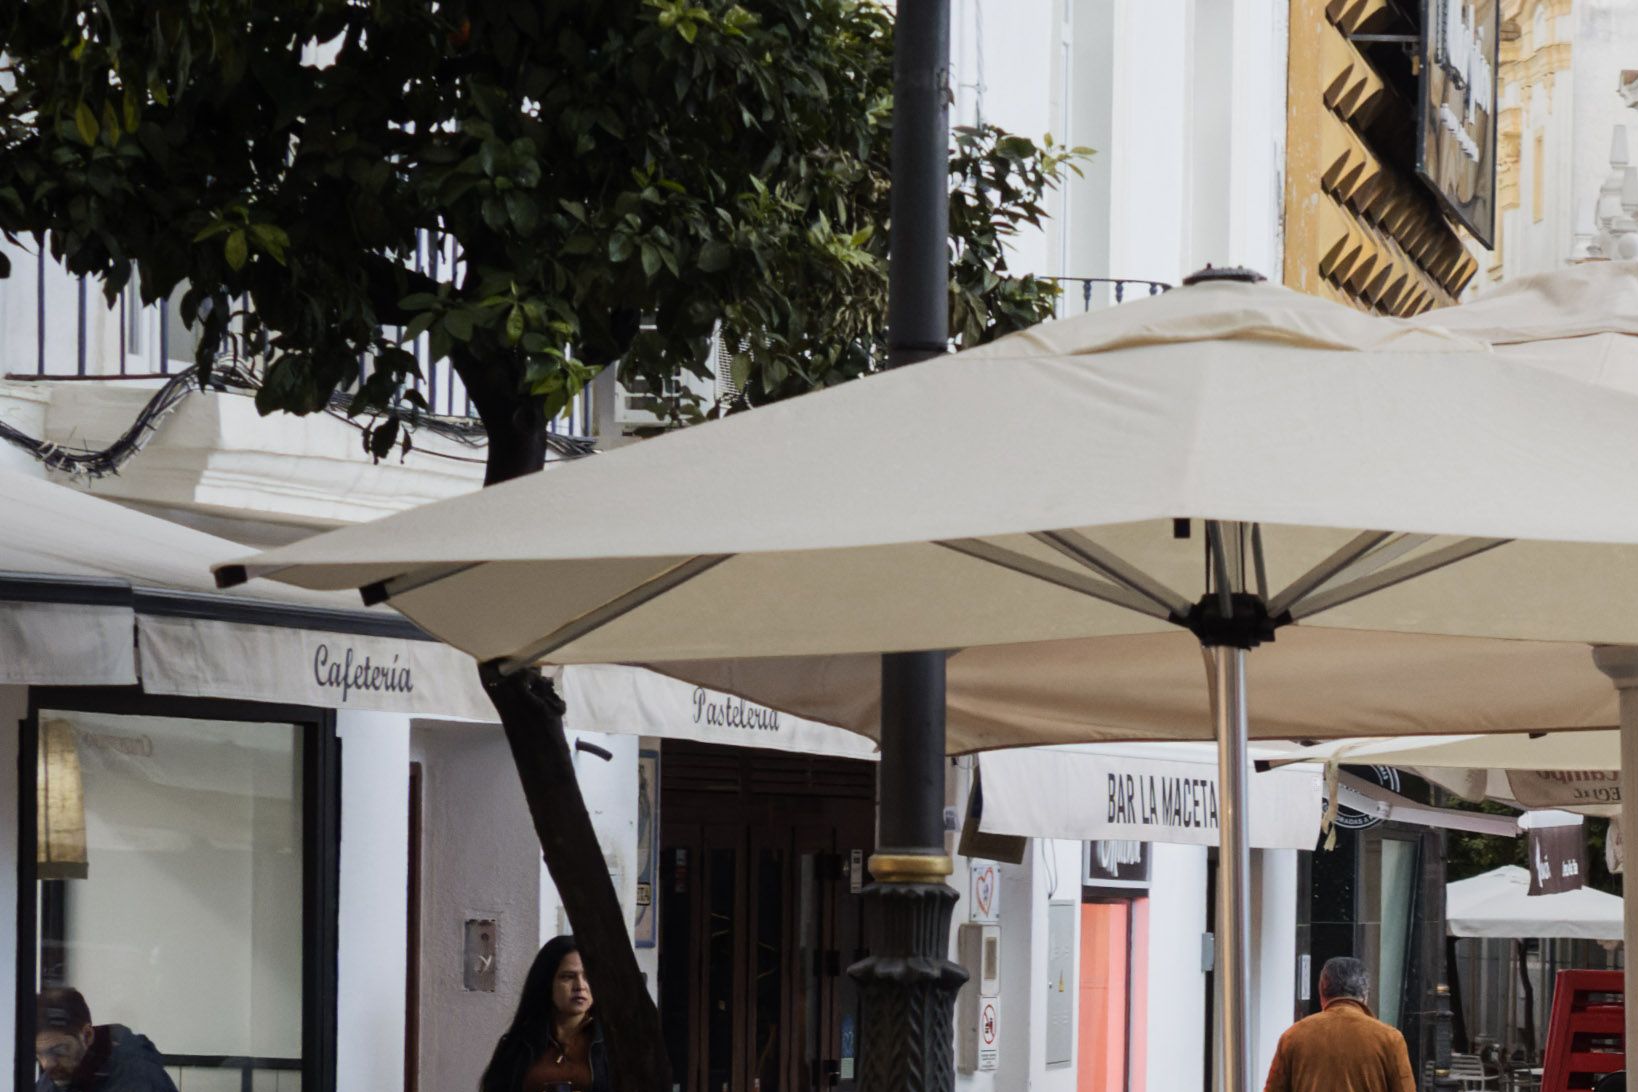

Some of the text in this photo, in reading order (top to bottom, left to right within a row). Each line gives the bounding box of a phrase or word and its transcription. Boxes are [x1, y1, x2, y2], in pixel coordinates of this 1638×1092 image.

[314, 644, 414, 702] Cafetería
[1107, 773, 1219, 828] BAR LA MACETA
